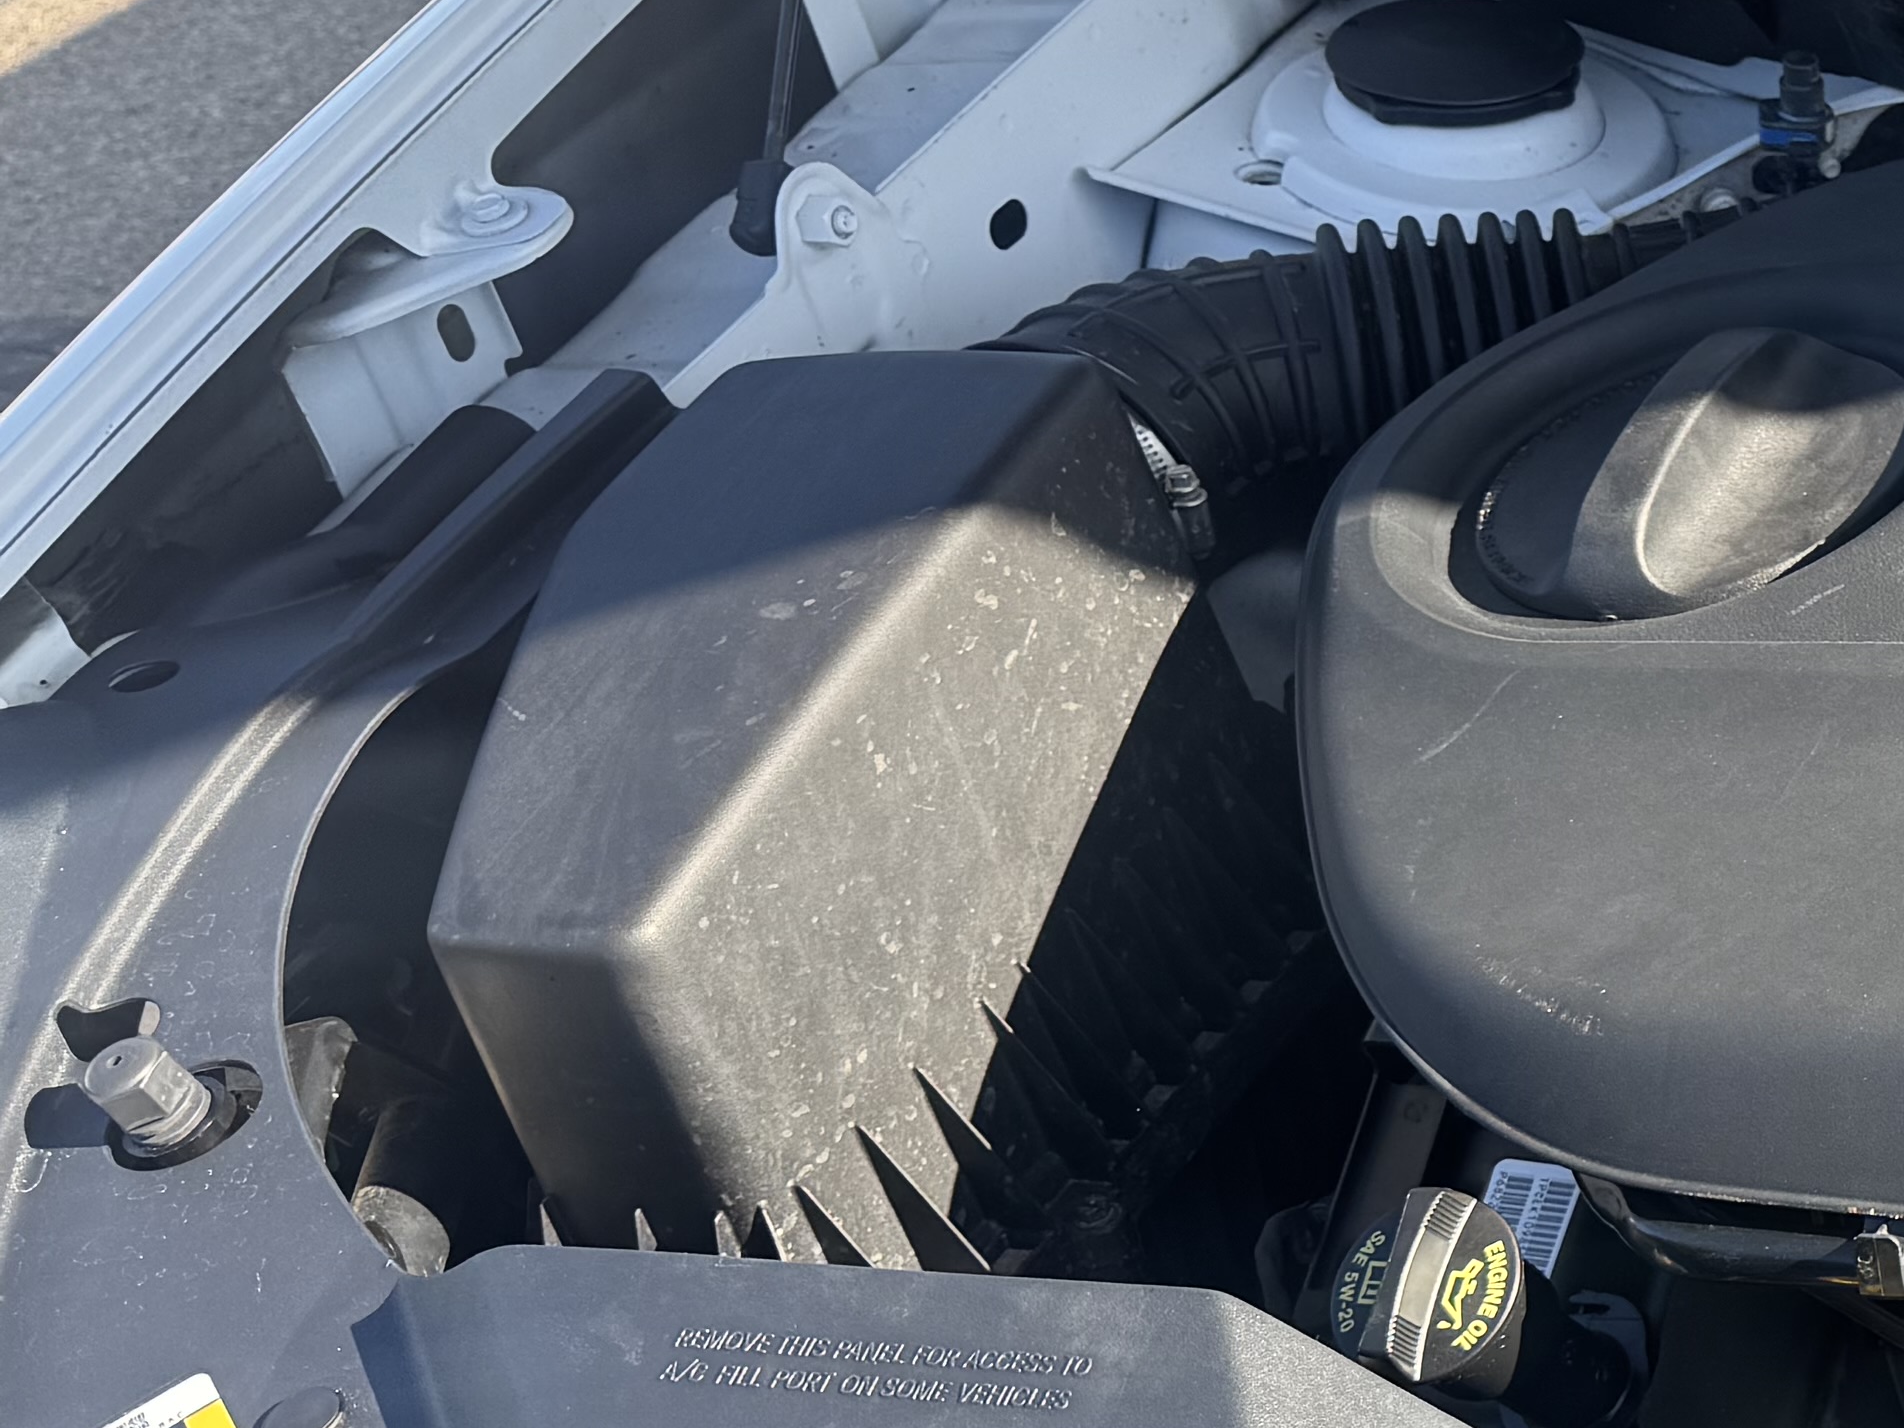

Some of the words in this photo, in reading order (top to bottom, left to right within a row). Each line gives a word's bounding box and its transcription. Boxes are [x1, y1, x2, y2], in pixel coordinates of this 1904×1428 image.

[1352, 1230, 1386, 1267] SAE
[1337, 1271, 1359, 1333] 5W-20
[1477, 1239, 1509, 1319] ENGINE
[674, 1326, 775, 1354] REMOVE
[777, 1334, 831, 1357] THIS
[832, 1339, 906, 1365] PANEL
[911, 1345, 961, 1368] FOR
[962, 1349, 1057, 1375] ACCESS
[1061, 1355, 1093, 1377] TO
[1450, 1318, 1488, 1351] OIL
[659, 1358, 709, 1383] A/C
[715, 1364, 762, 1388] FILL
[770, 1369, 837, 1393] PORT
[840, 1374, 879, 1397] ON
[880, 1376, 954, 1403] SOME
[958, 1381, 1073, 1410] VEHICLES
